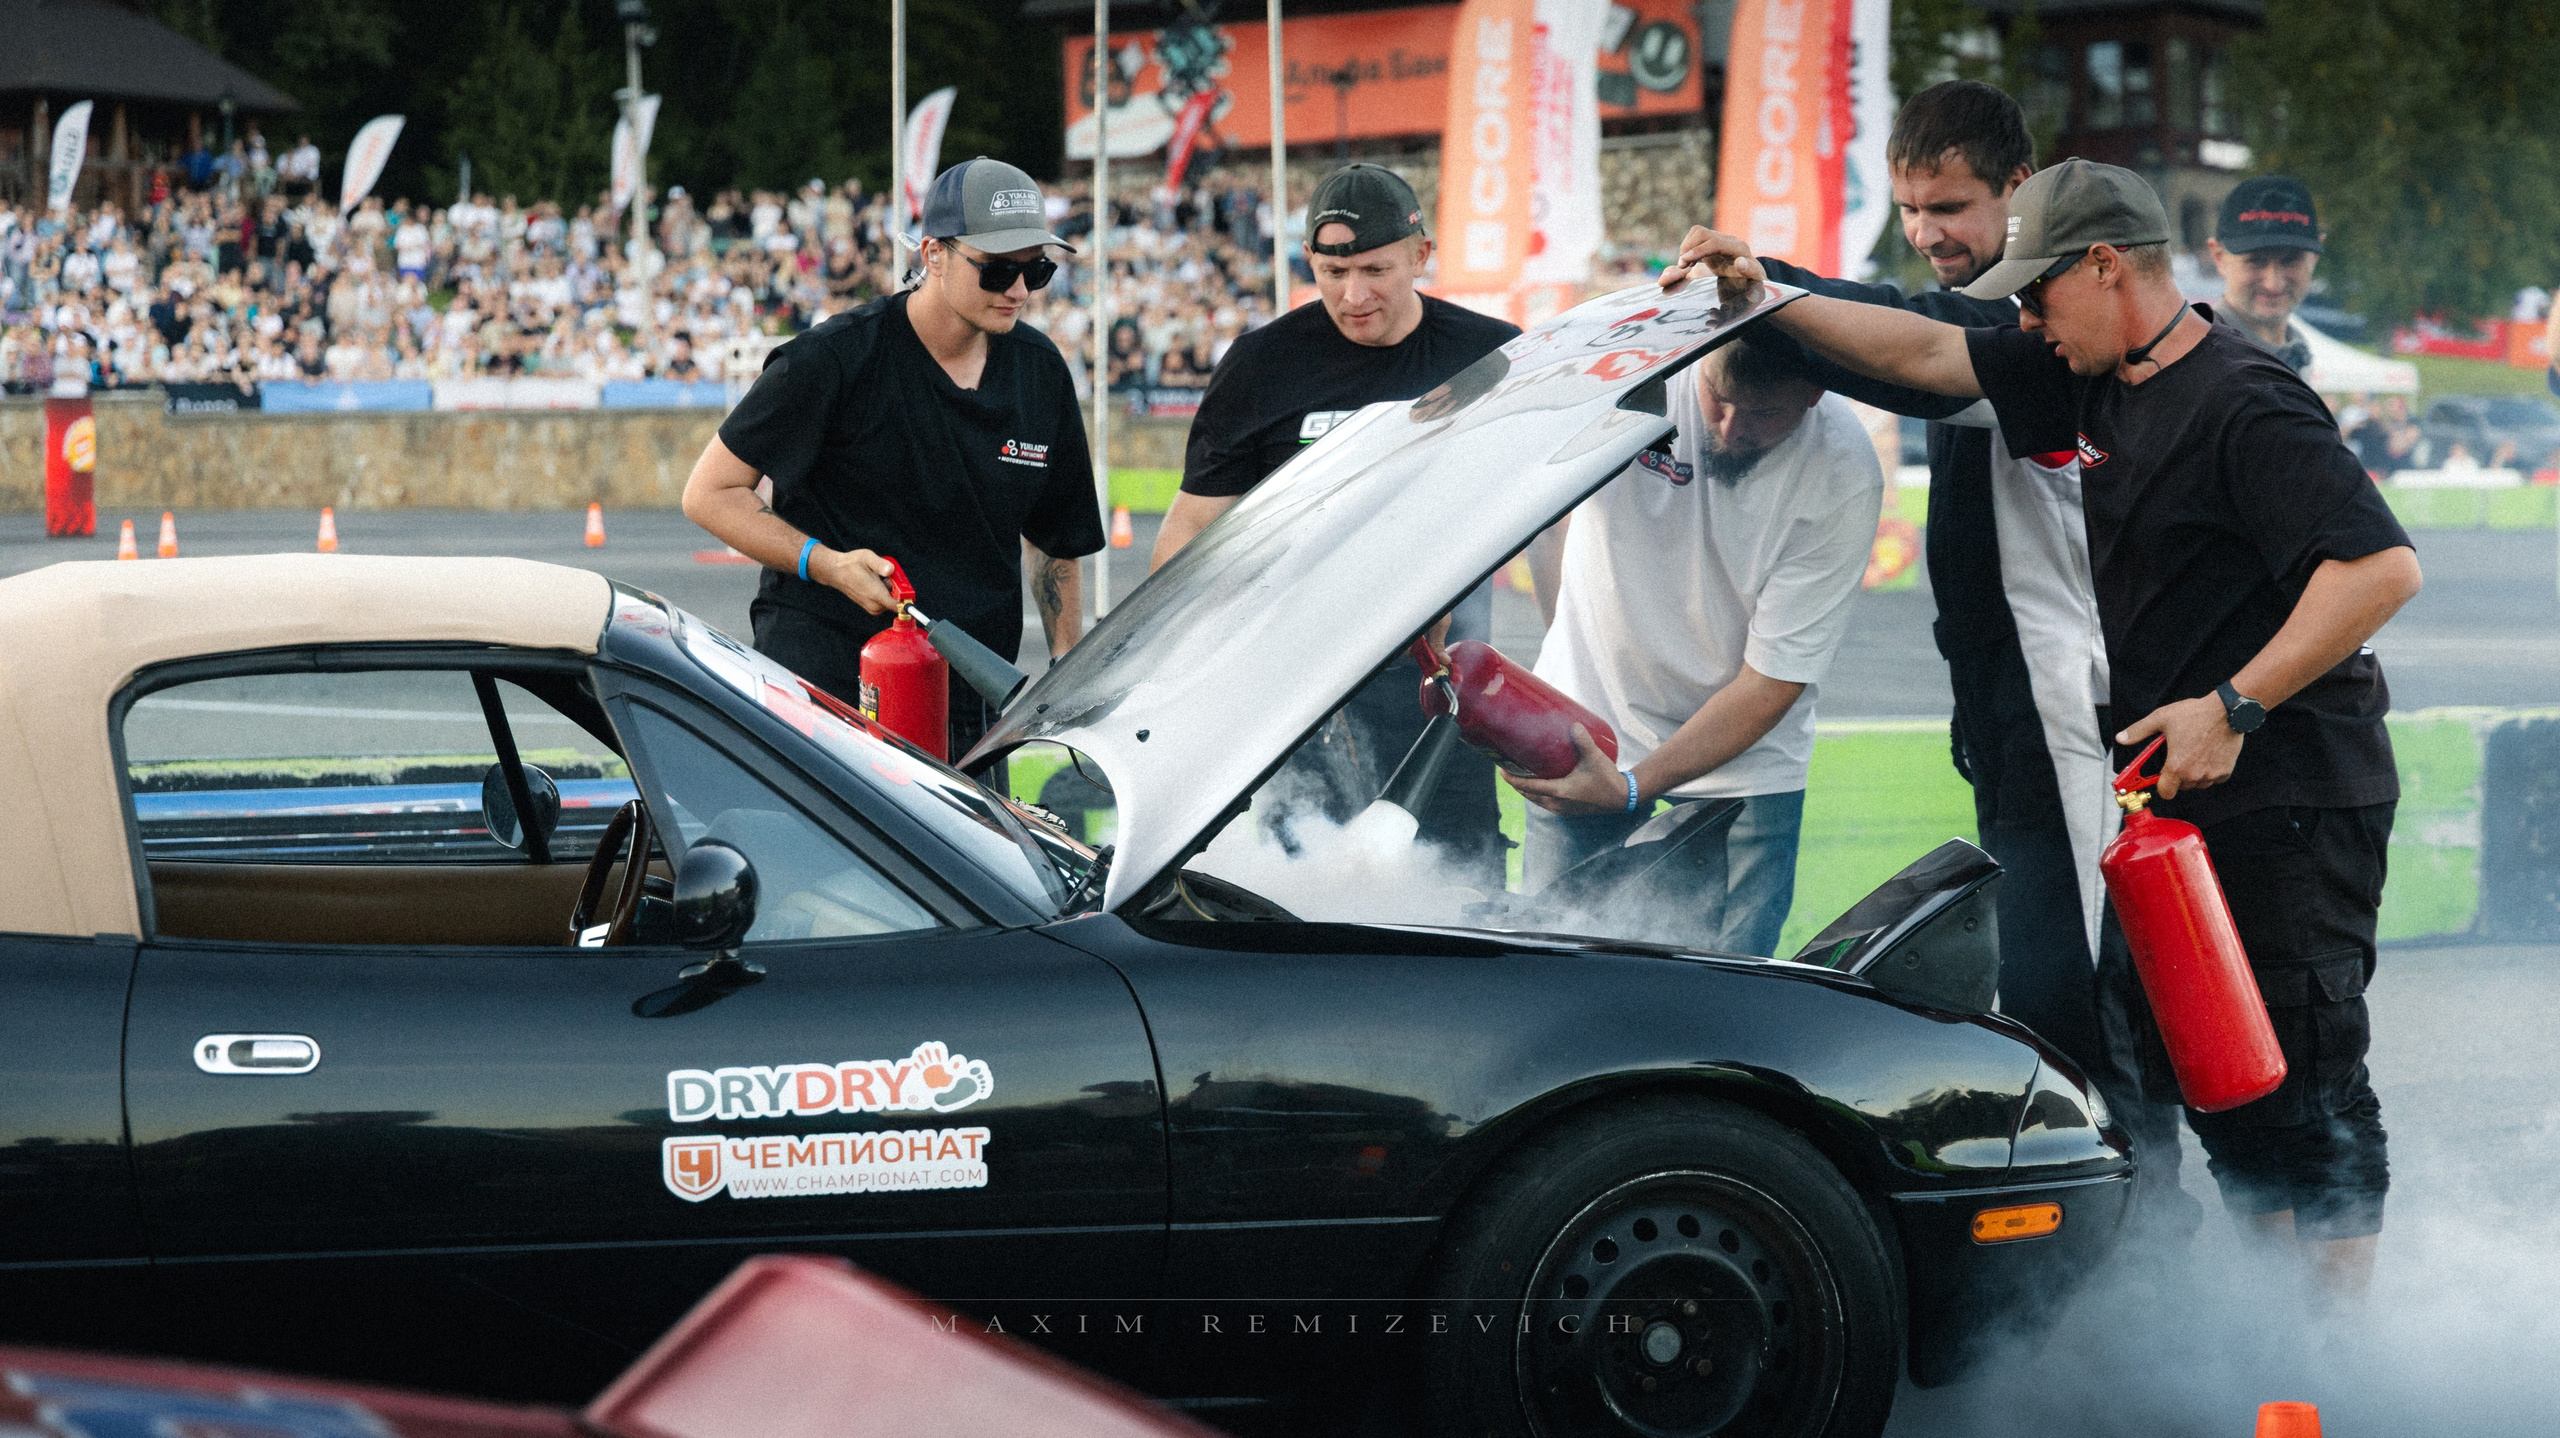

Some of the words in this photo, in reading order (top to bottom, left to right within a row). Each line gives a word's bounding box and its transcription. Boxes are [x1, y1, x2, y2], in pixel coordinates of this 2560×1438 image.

[1469, 15, 1514, 216] CORE
[1755, 0, 1804, 197] CORE
[674, 1065, 912, 1117] DRYDRY
[732, 1134, 985, 1169] ЧЕМПИОНАТ
[732, 1168, 983, 1193] WWW.CHAMPIONAT.COM
